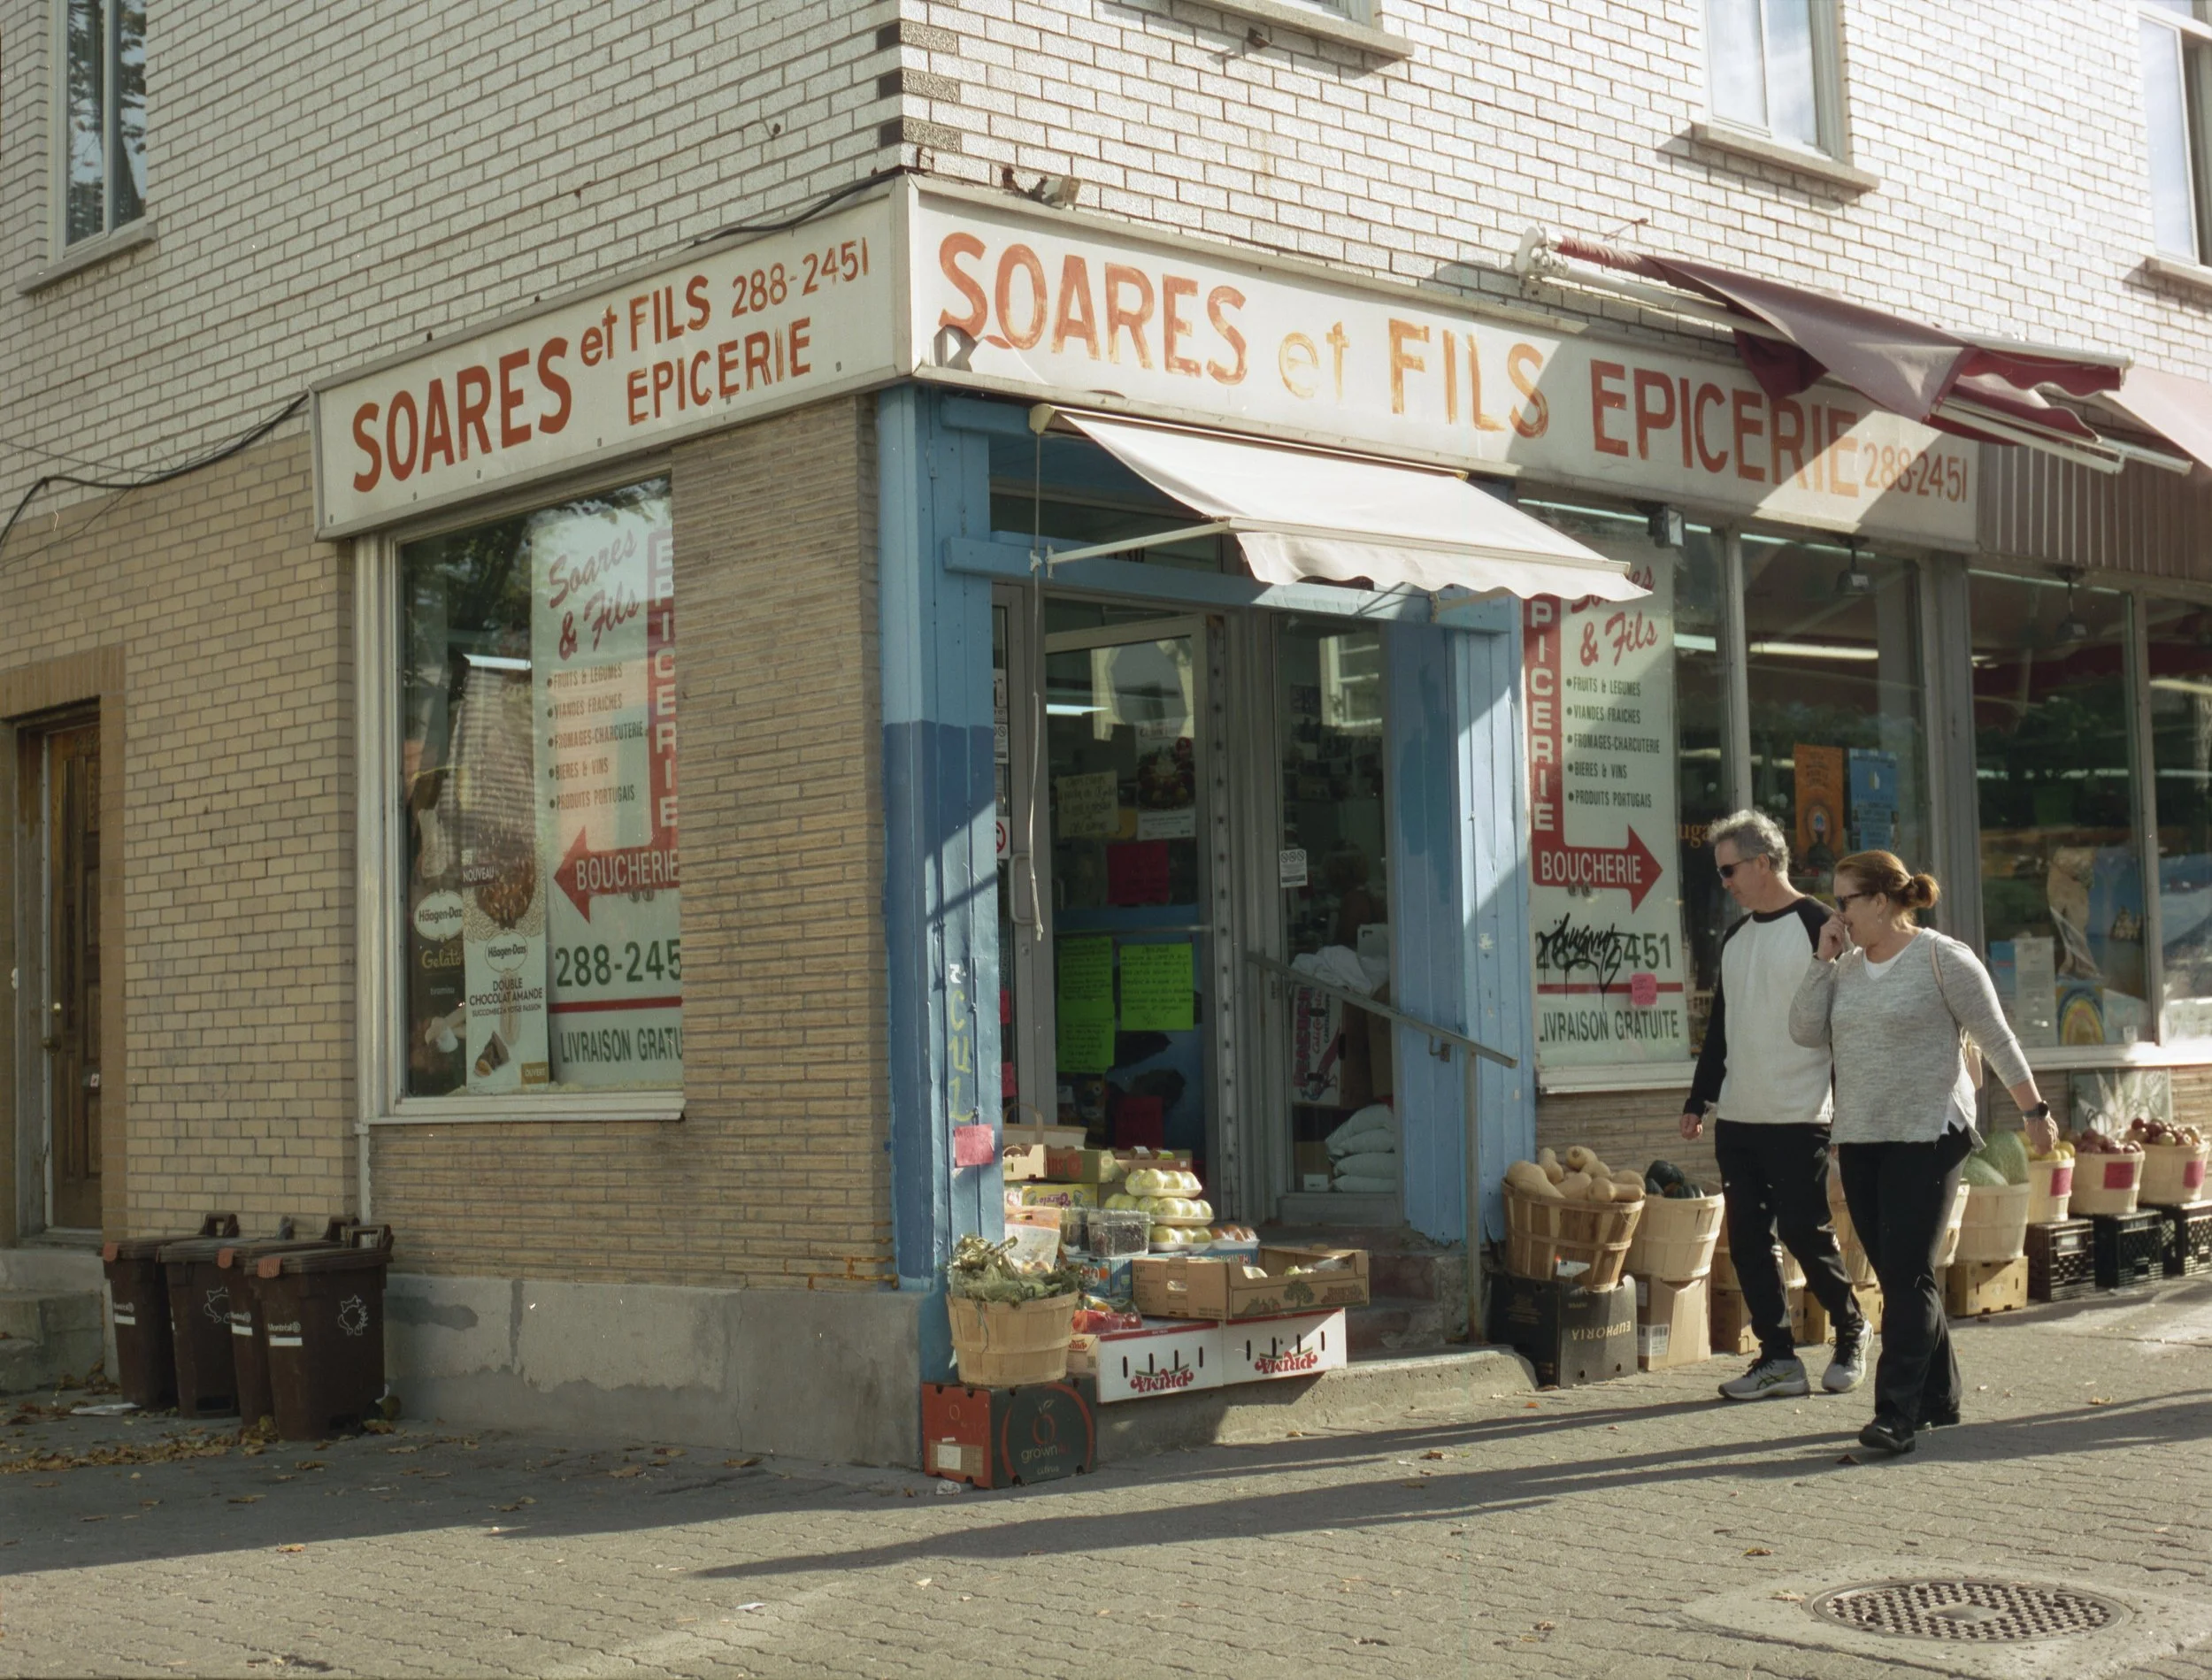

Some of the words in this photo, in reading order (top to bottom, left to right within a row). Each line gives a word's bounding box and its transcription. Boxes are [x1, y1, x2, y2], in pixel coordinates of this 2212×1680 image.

[938, 231, 1248, 386] SOARES
[1279, 320, 1350, 399] et
[1388, 317, 1548, 440] FILS
[352, 336, 572, 493] SOARES
[580, 303, 618, 366] et
[630, 275, 710, 351] FILS
[732, 237, 869, 318] 288-2451
[628, 317, 811, 426] EPICERIE
[1590, 358, 1859, 498] EPICERIE
[1864, 443, 1967, 502] 288-2451
[549, 529, 637, 609] Soares
[559, 610, 578, 661] &
[584, 581, 640, 651] Fils
[1580, 621, 1599, 667] &
[1605, 610, 1658, 666] Fils
[554, 671, 578, 688] FRUITS
[590, 664, 623, 683] LEGUMES
[1573, 676, 1598, 693] FRUITS
[1610, 679, 1640, 697] LEGUMES
[554, 700, 584, 719] VIANDES
[588, 694, 623, 713] FRAICHES
[1573, 704, 1604, 721] VIANDES
[1608, 707, 1640, 725] FRAICHES
[555, 721, 643, 749] FROMAGES-CHARCUTERIE
[1573, 733, 1660, 754] FROMAGES-CHARCUTERIE
[556, 762, 579, 780] BIERES
[591, 757, 609, 775] VINS
[1574, 762, 1598, 778] BIERES
[1611, 763, 1627, 779] VINS
[557, 790, 591, 810] PRODUITS
[594, 784, 635, 805] PORTUGAIS
[1575, 789, 1610, 807] PRODUITS
[1612, 791, 1652, 808] PORTUGAIS
[463, 865, 495, 883] NOUVEAU
[576, 849, 680, 891] BOUCHERIE
[1541, 851, 1642, 884] BOUCHERIE
[469, 992, 511, 1006] CHOCOLAT
[512, 987, 542, 1001] AMANDE
[493, 978, 523, 992] DOUBLE
[1540, 1009, 1609, 1043] IVRAISON
[1615, 1009, 1679, 1040] GRATUITE
[560, 1028, 632, 1062] LIVRAISON
[1571, 1320, 1632, 1341] EUPHORIA
[1255, 1349, 1318, 1375] PRIMA
[1131, 1368, 1194, 1393] PRIMA
